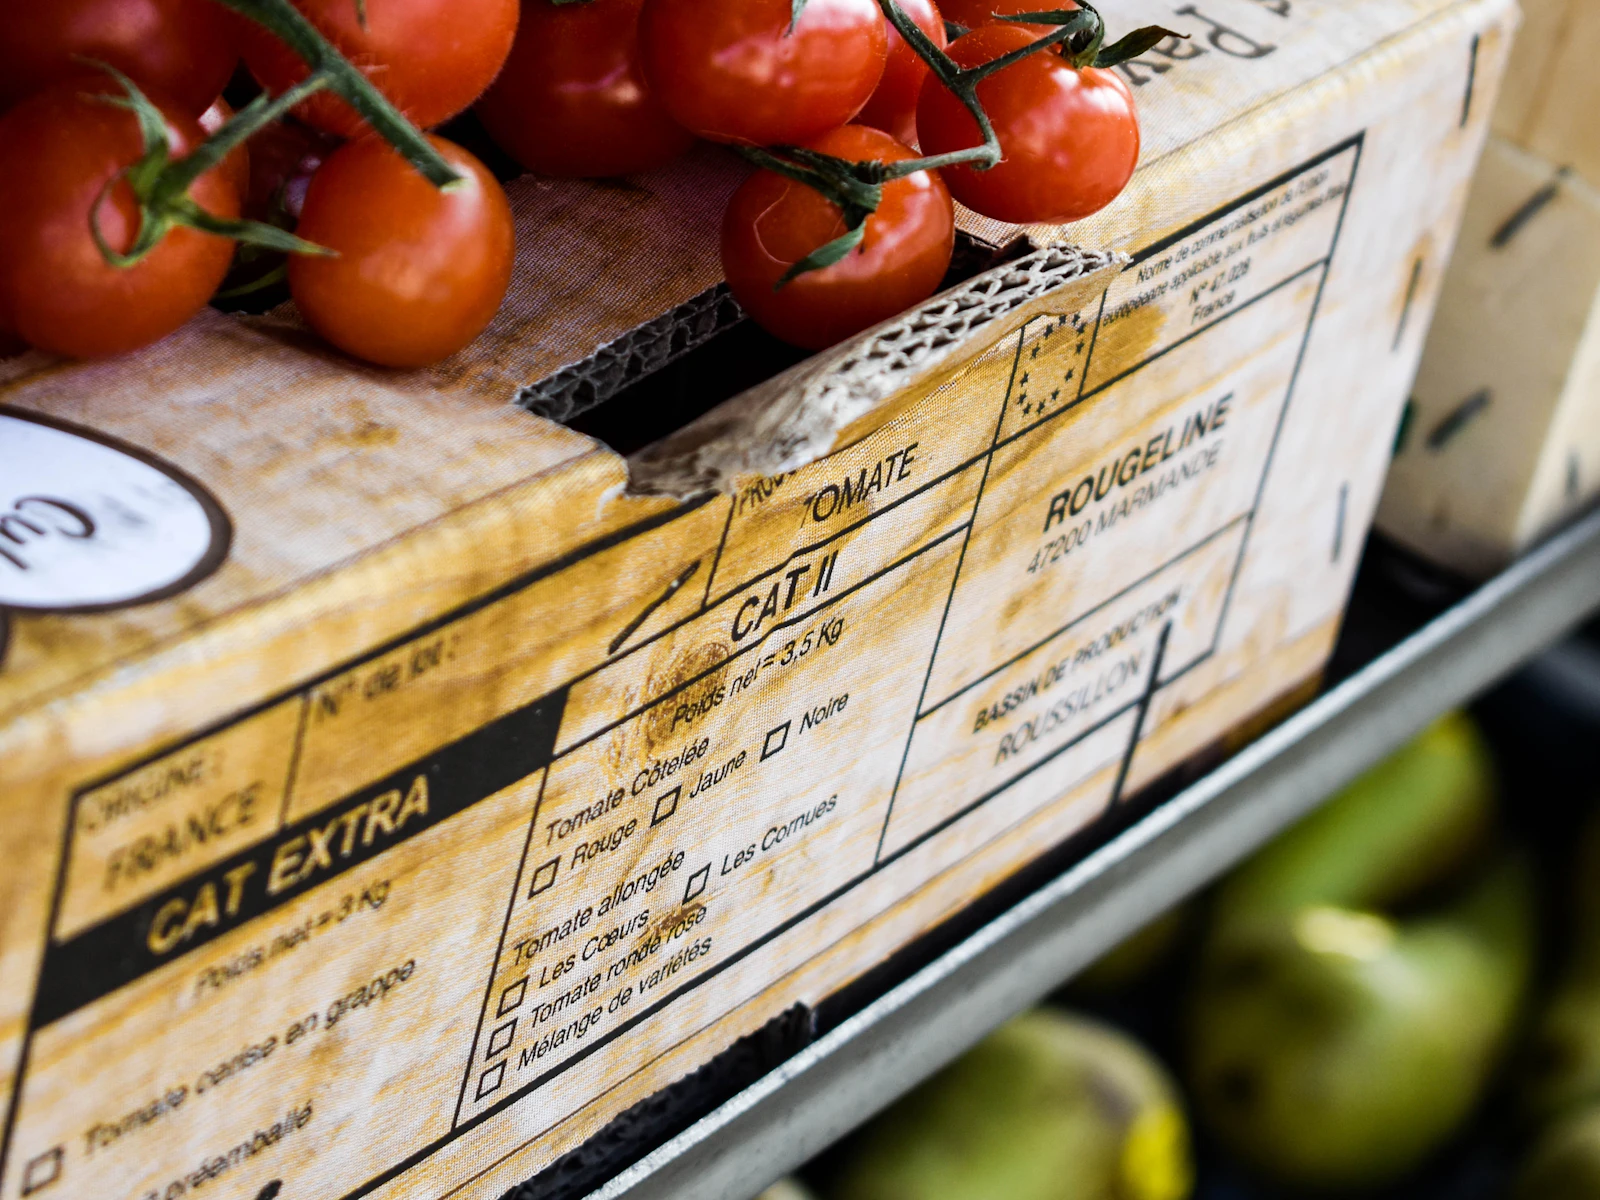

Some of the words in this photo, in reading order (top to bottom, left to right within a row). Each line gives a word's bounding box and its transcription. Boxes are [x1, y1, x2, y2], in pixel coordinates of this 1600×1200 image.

[1136, 254, 1173, 285] Norme
[1175, 245, 1190, 264] de
[1191, 289, 1236, 327] France
[799, 442, 918, 529] TOMATE
[1026, 522, 1092, 575] 47200
[1094, 441, 1222, 538] MARMANDE
[1042, 393, 1234, 532] ROUGELINE
[731, 563, 811, 642] CAT
[813, 549, 840, 598] II
[671, 685, 726, 733] Poids
[779, 633, 814, 667] 3,5
[818, 615, 845, 647] Kg
[799, 692, 850, 736] Noire
[972, 673, 1042, 735] BASSIN
[1042, 656, 1070, 690] DE
[994, 645, 1145, 768] ROUSSILLON
[546, 783, 626, 847] Tomate
[631, 736, 711, 797] Côtelée
[690, 749, 748, 799] Jaune
[105, 779, 266, 892] FRANCE
[146, 861, 258, 955] CAT
[266, 773, 431, 896] EXTRA
[570, 817, 638, 870] Rouge
[720, 841, 755, 877] Les
[760, 792, 839, 852] Cornues
[513, 903, 594, 967] Tomate
[598, 849, 686, 913] allongée
[538, 952, 576, 990] Les
[582, 908, 651, 963] Cœurs
[517, 1008, 603, 1073] Mélange
[608, 985, 634, 1013] de
[637, 935, 712, 992] variétés
[530, 971, 602, 1029] Tomate
[606, 933, 661, 980] ronde
[665, 905, 708, 944] rose
[84, 1083, 189, 1157] Tomate
[284, 1010, 319, 1046] en
[324, 957, 417, 1031] grappe
